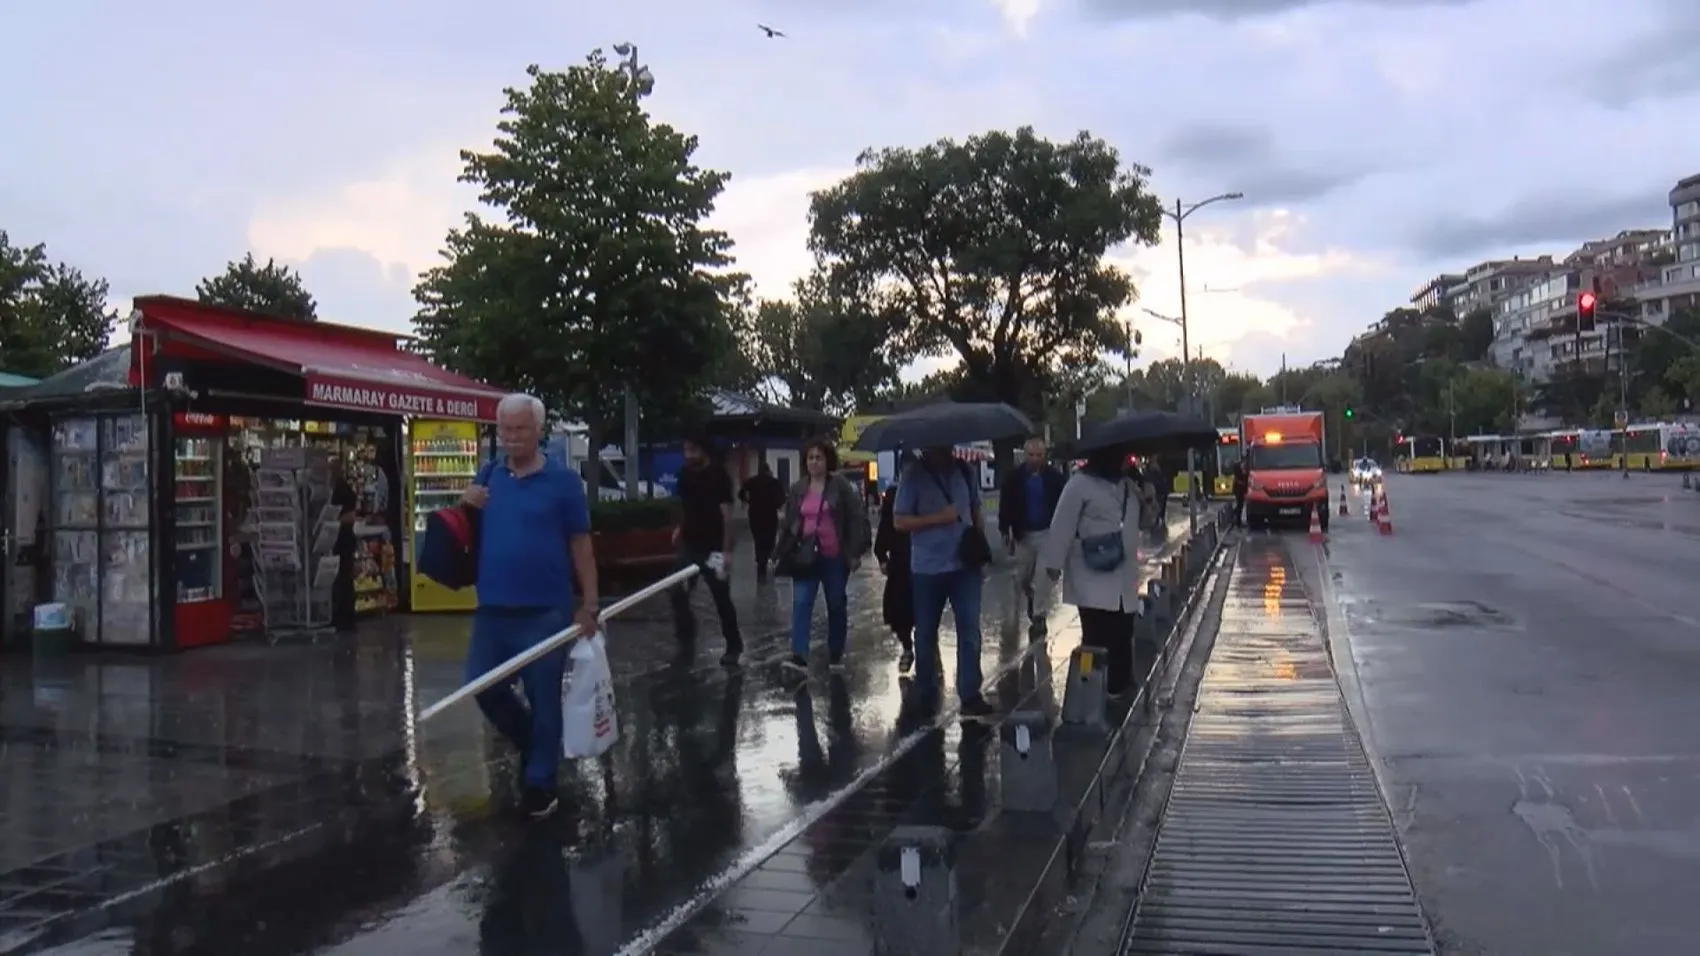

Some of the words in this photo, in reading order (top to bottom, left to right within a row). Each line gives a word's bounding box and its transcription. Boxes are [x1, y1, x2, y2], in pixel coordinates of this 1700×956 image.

[313, 383, 385, 408] MARMARAY
[389, 394, 433, 414] GAZETE
[436, 400, 444, 413] &
